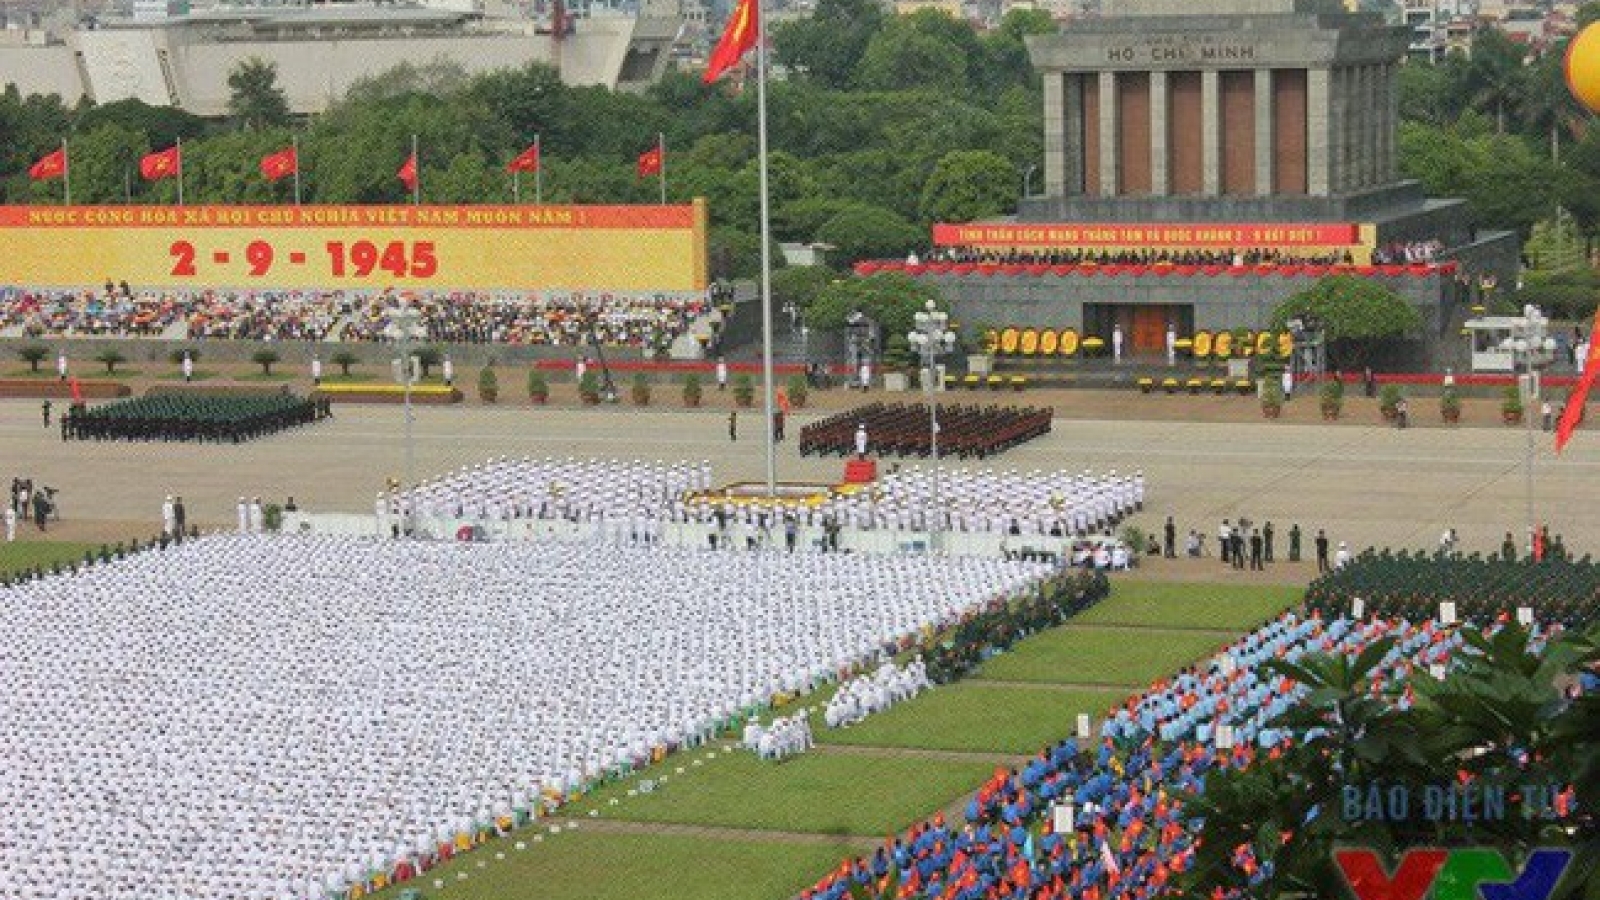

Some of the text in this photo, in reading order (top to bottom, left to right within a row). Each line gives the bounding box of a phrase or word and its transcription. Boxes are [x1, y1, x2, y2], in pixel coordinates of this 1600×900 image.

[1200, 45, 1255, 60] MINH
[416, 210, 459, 224] NAM
[169, 240, 196, 276] 2
[245, 240, 274, 276] 9
[326, 240, 438, 278] 1945
